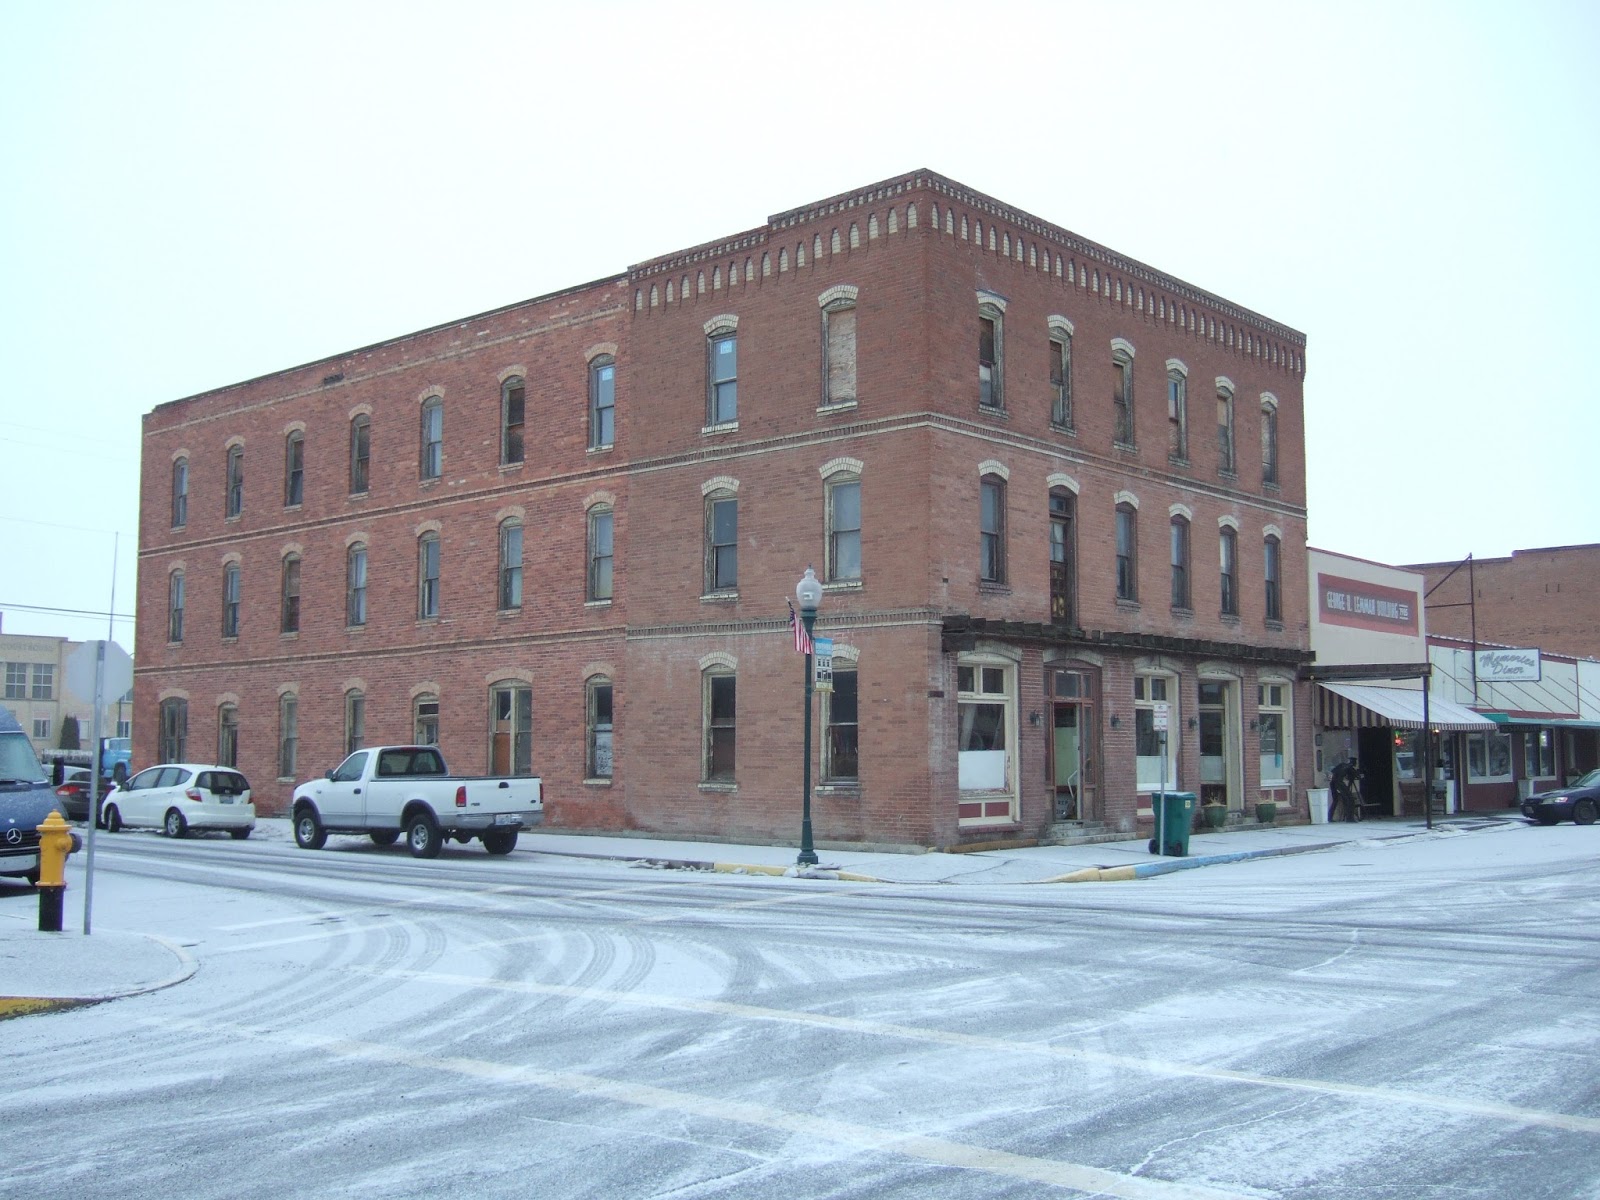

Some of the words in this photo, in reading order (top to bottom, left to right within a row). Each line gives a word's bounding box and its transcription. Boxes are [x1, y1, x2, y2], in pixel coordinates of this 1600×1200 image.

[1326, 591, 1345, 611] GEORGE
[1376, 600, 1398, 619] BUILDING
[1480, 652, 1535, 668] Memories
[1492, 662, 1524, 675] Diner
